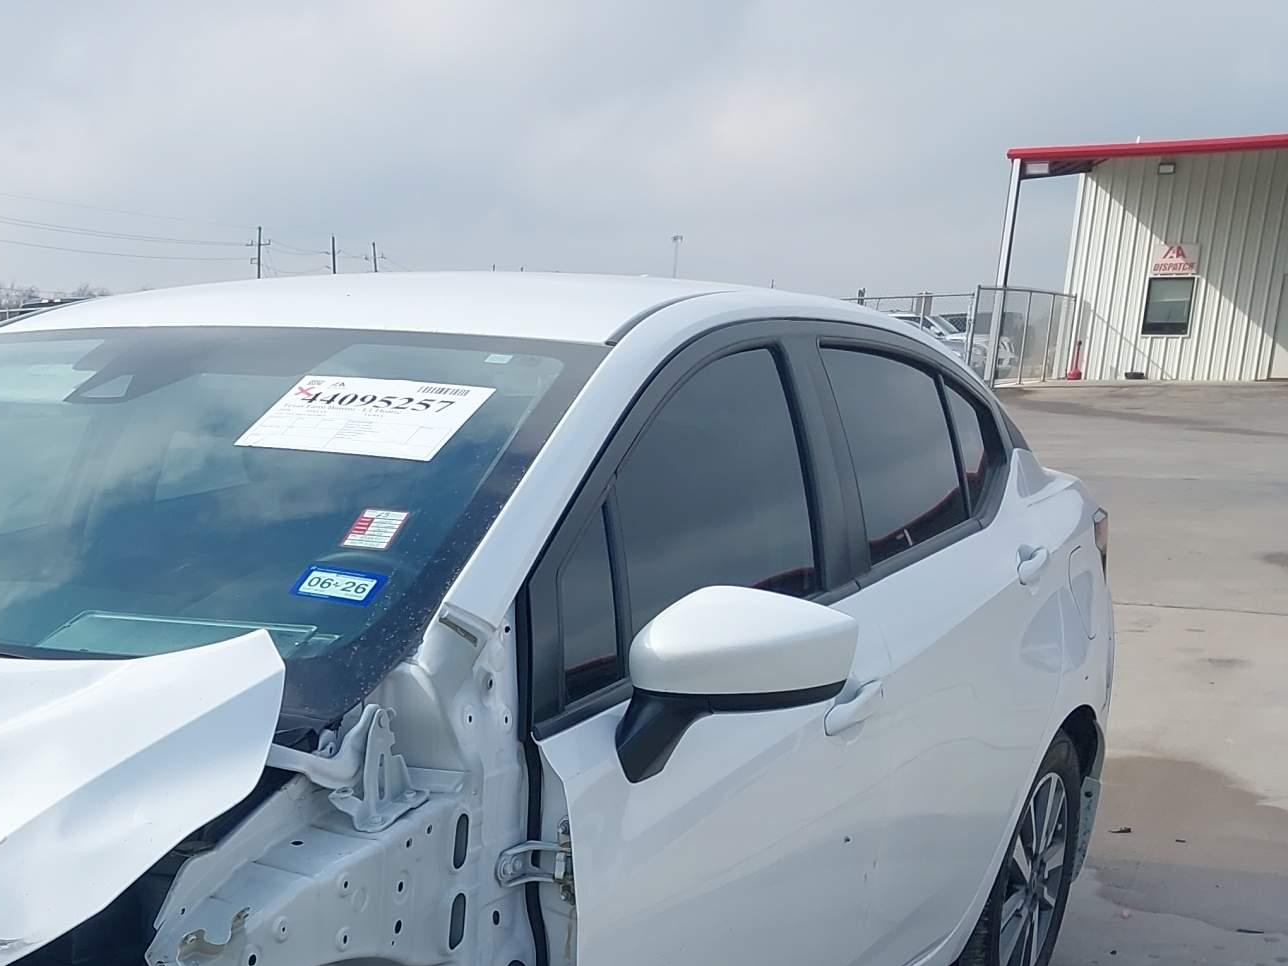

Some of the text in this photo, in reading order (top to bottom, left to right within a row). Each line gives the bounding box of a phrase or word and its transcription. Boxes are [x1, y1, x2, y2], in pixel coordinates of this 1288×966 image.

[1152, 262, 1196, 272] DISPATCH
[301, 391, 455, 413] 44095257
[307, 576, 369, 594] 06 26
